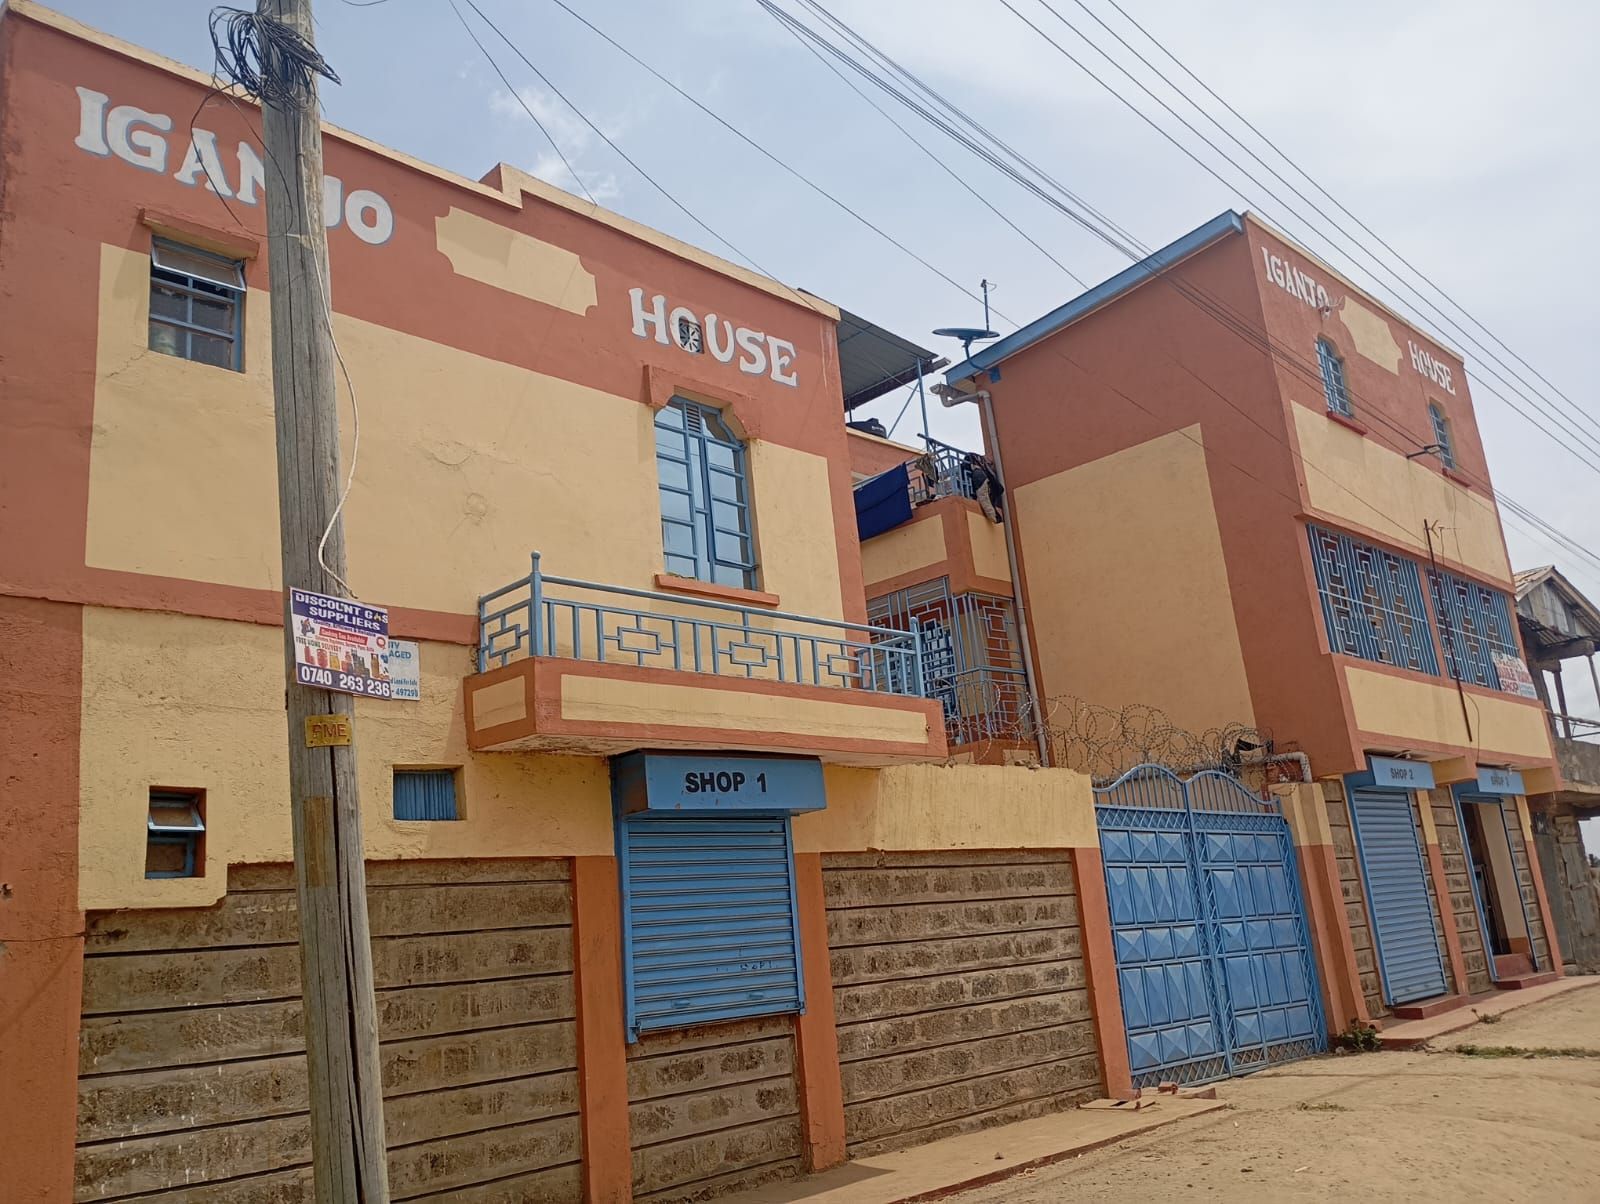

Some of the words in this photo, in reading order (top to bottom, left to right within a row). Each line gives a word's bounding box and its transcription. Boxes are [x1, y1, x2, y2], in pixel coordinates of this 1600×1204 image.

[1261, 246, 1332, 309] IGANJO
[1407, 340, 1456, 396] HOUSE
[628, 287, 798, 387] HOUSE
[295, 592, 361, 617] DISCOUNT
[308, 606, 381, 631] SUPPLIERS
[300, 665, 333, 686] 0740
[340, 673, 364, 692] 263
[367, 679, 390, 697] 236
[685, 771, 746, 793] SHOP
[756, 772, 767, 793] 1
[1390, 767, 1407, 780] SHOP
[1408, 768, 1414, 781] 2
